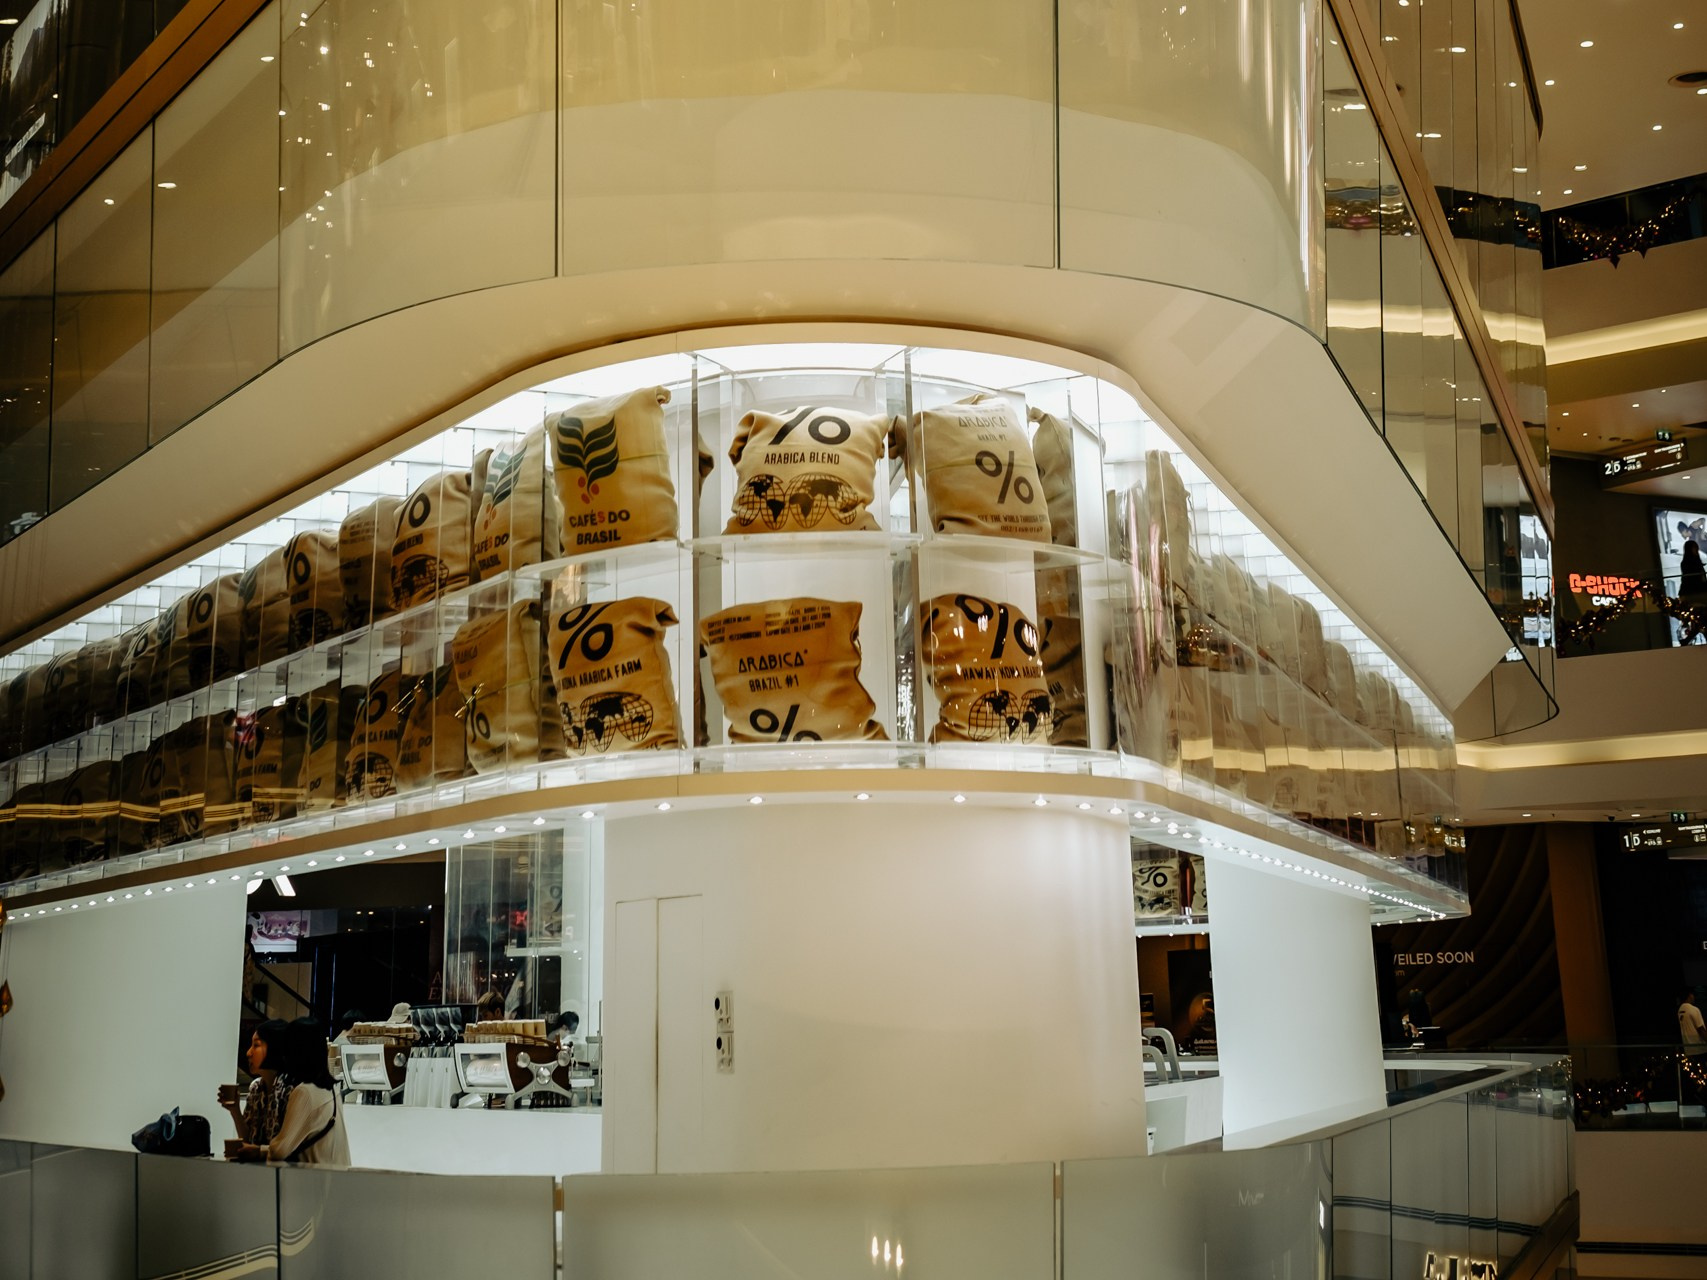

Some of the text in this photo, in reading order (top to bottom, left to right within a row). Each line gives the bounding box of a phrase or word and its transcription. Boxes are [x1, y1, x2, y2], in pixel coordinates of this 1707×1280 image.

[764, 452, 840, 465] ARABICA BLEND
[568, 509, 630, 528] CAFÉS DO
[494, 533, 509, 548] DO
[576, 529, 621, 545] BRASIL
[738, 651, 804, 673] ARABICA
[579, 667, 613, 687] ARABICA
[615, 658, 642, 678] FARM
[749, 674, 799, 692] BRAZIL #1
[1436, 951, 1475, 964] SOON
